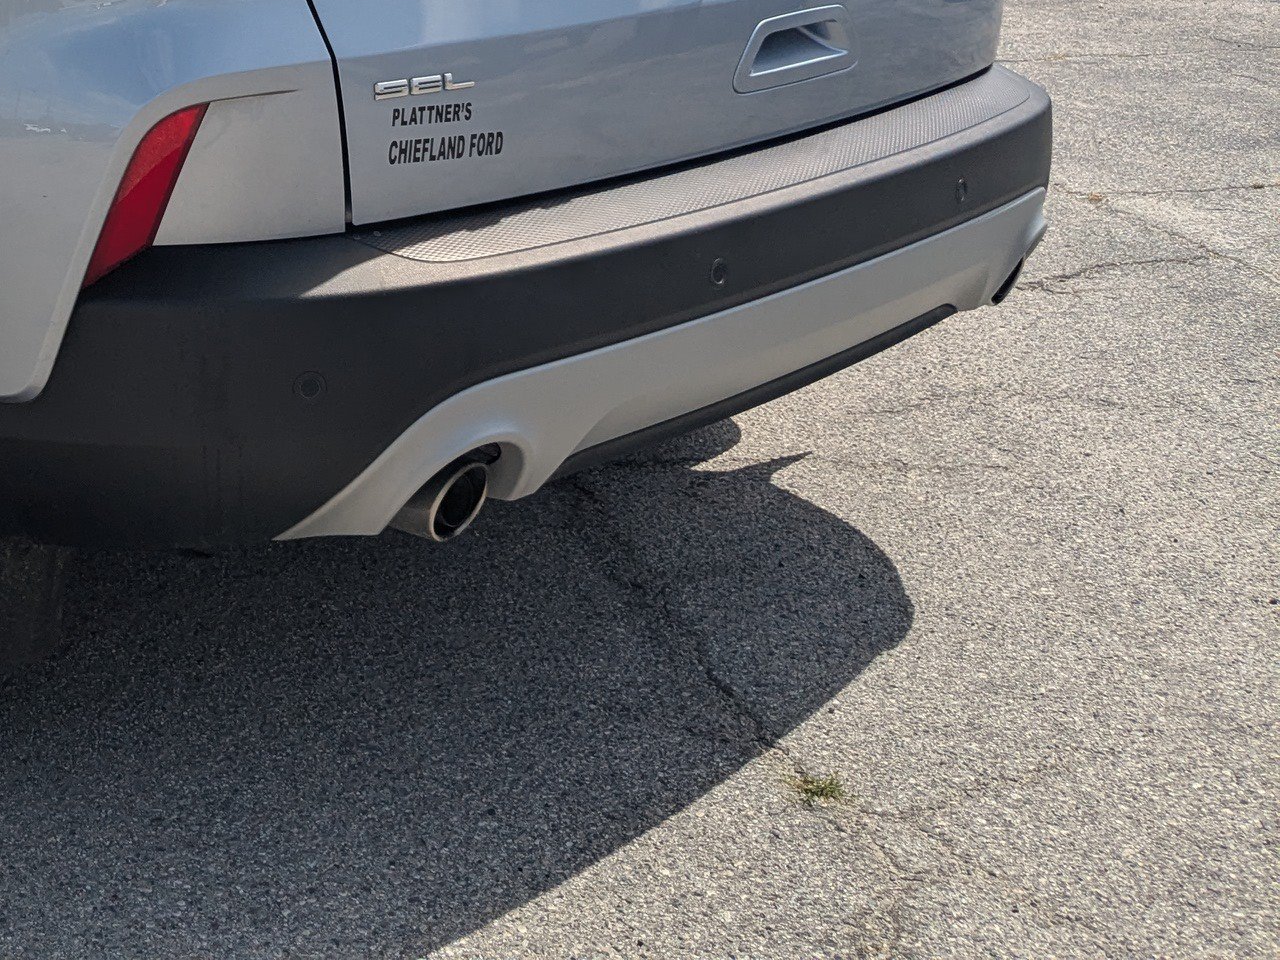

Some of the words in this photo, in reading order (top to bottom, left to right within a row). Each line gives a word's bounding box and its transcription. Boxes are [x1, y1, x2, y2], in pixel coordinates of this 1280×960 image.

[374, 72, 475, 101] SEL
[391, 102, 472, 127] PLATTNER'S
[388, 135, 466, 165] CHIEFLAND
[468, 131, 504, 158] FORD
